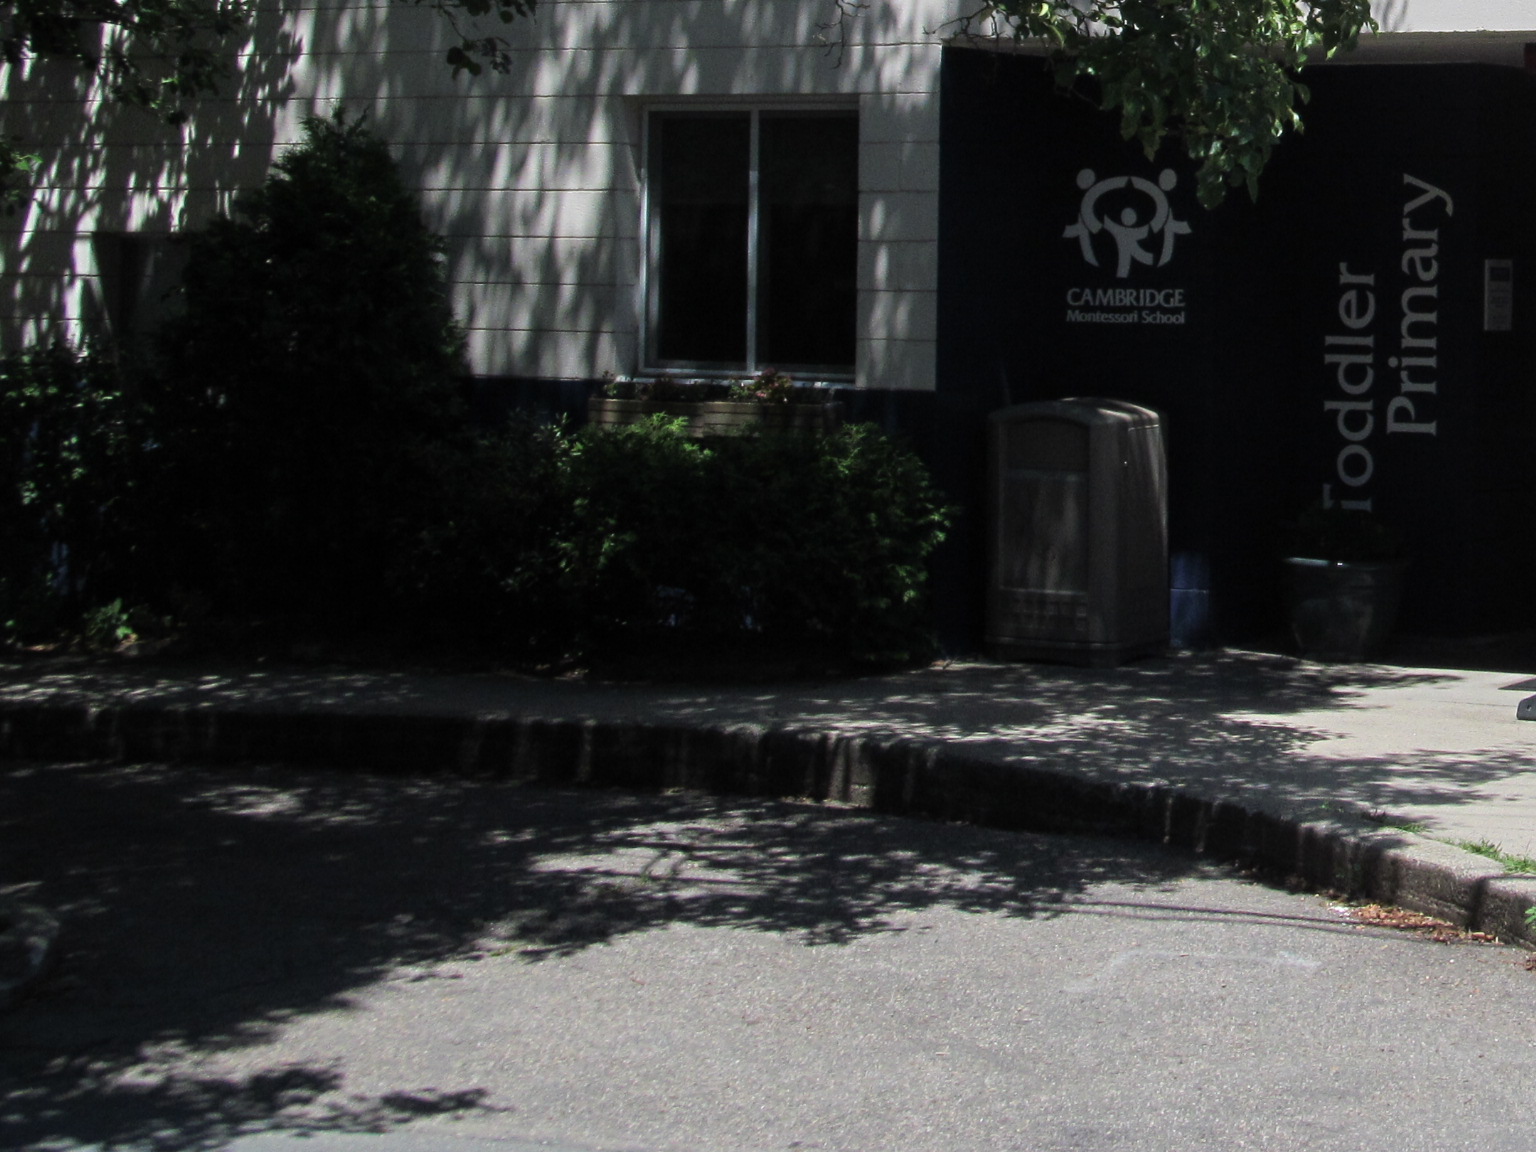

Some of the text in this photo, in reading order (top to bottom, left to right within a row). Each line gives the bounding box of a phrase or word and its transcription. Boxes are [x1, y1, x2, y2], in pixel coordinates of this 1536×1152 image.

[1065, 287, 1187, 309] CAMBRIDGE
[1065, 310, 1186, 325] Montessori School
[1385, 173, 1454, 437] Primary
[1322, 261, 1377, 514] Toddler
